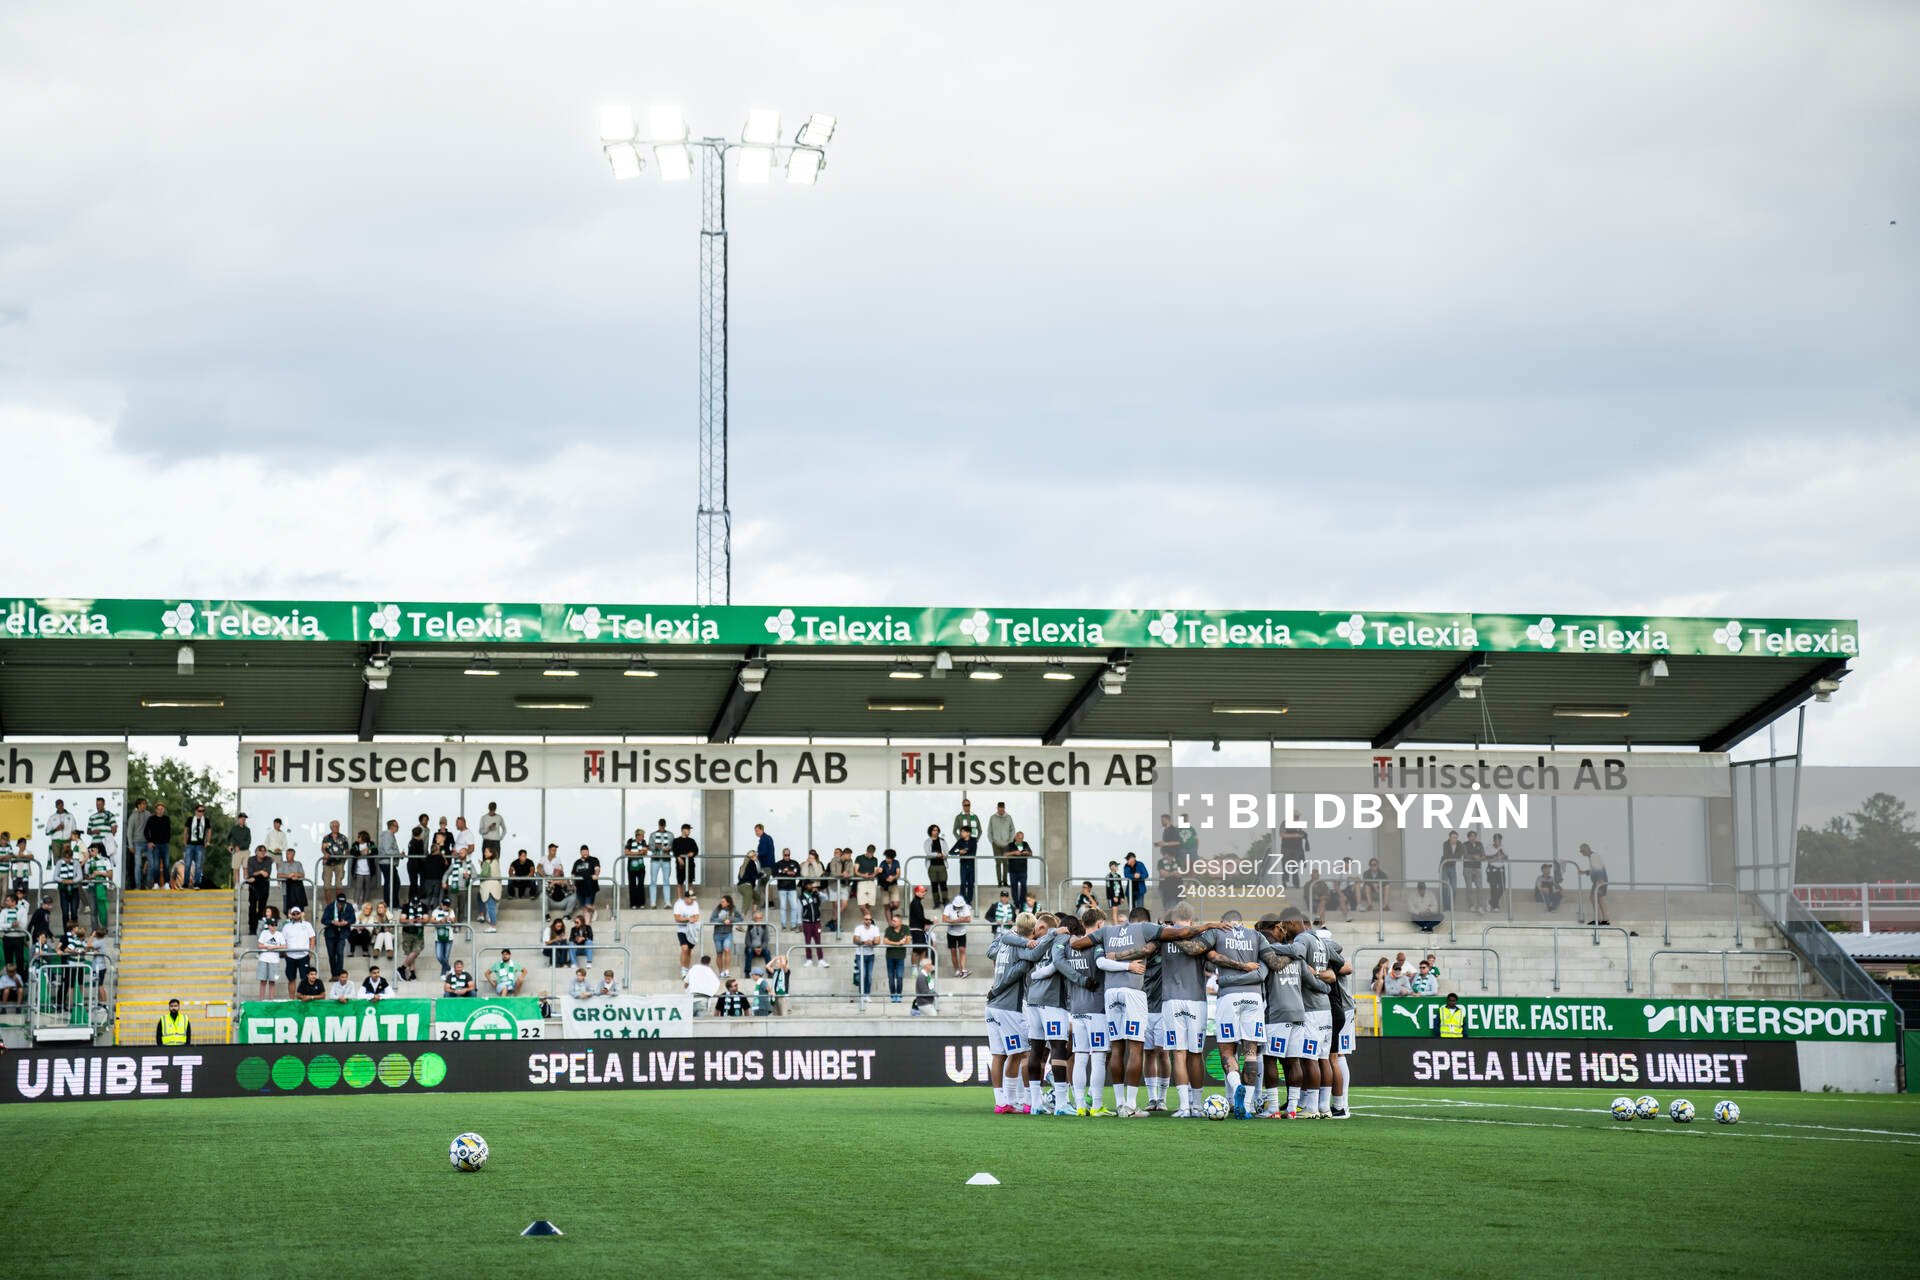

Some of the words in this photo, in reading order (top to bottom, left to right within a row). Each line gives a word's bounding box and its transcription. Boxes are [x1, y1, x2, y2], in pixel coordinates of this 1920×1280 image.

[202, 610, 319, 636] Telexia
[407, 611, 522, 638] Telexia
[607, 613, 719, 640] Telexia
[801, 615, 911, 641] Telexia
[996, 617, 1104, 643] Telexia
[1184, 619, 1291, 645] Telexia
[1371, 621, 1479, 647] Telexia
[1561, 624, 1670, 650] Telexia
[1748, 627, 1858, 654] Telexia
[49, 750, 111, 783] AB
[283, 748, 456, 783] Hisstech
[472, 750, 529, 783] AB
[611, 749, 778, 784] Hisstech
[792, 751, 848, 784] AB
[928, 751, 1090, 786] Hisstech
[1104, 754, 1158, 786] AB
[1400, 756, 1560, 791] Hisstech
[1573, 758, 1628, 791] AB
[573, 1004, 682, 1022] GRÖNVITA
[1428, 1004, 1526, 1030] FEVER.
[1531, 1005, 1613, 1031] FASTER.
[1678, 1005, 1887, 1036] INTERSPORT
[440, 1030, 460, 1041] 20
[521, 1028, 540, 1038] 22
[17, 1055, 203, 1098] UNIBET
[529, 1051, 624, 1084] SPELA
[633, 1051, 695, 1082] LIVE
[704, 1050, 764, 1081] HOS
[773, 1049, 876, 1081] UNIBET
[1412, 1050, 1504, 1081] SPELA
[1512, 1051, 1570, 1082] LIVE
[1581, 1052, 1639, 1083] HOS
[1646, 1053, 1748, 1084] UNIBET
